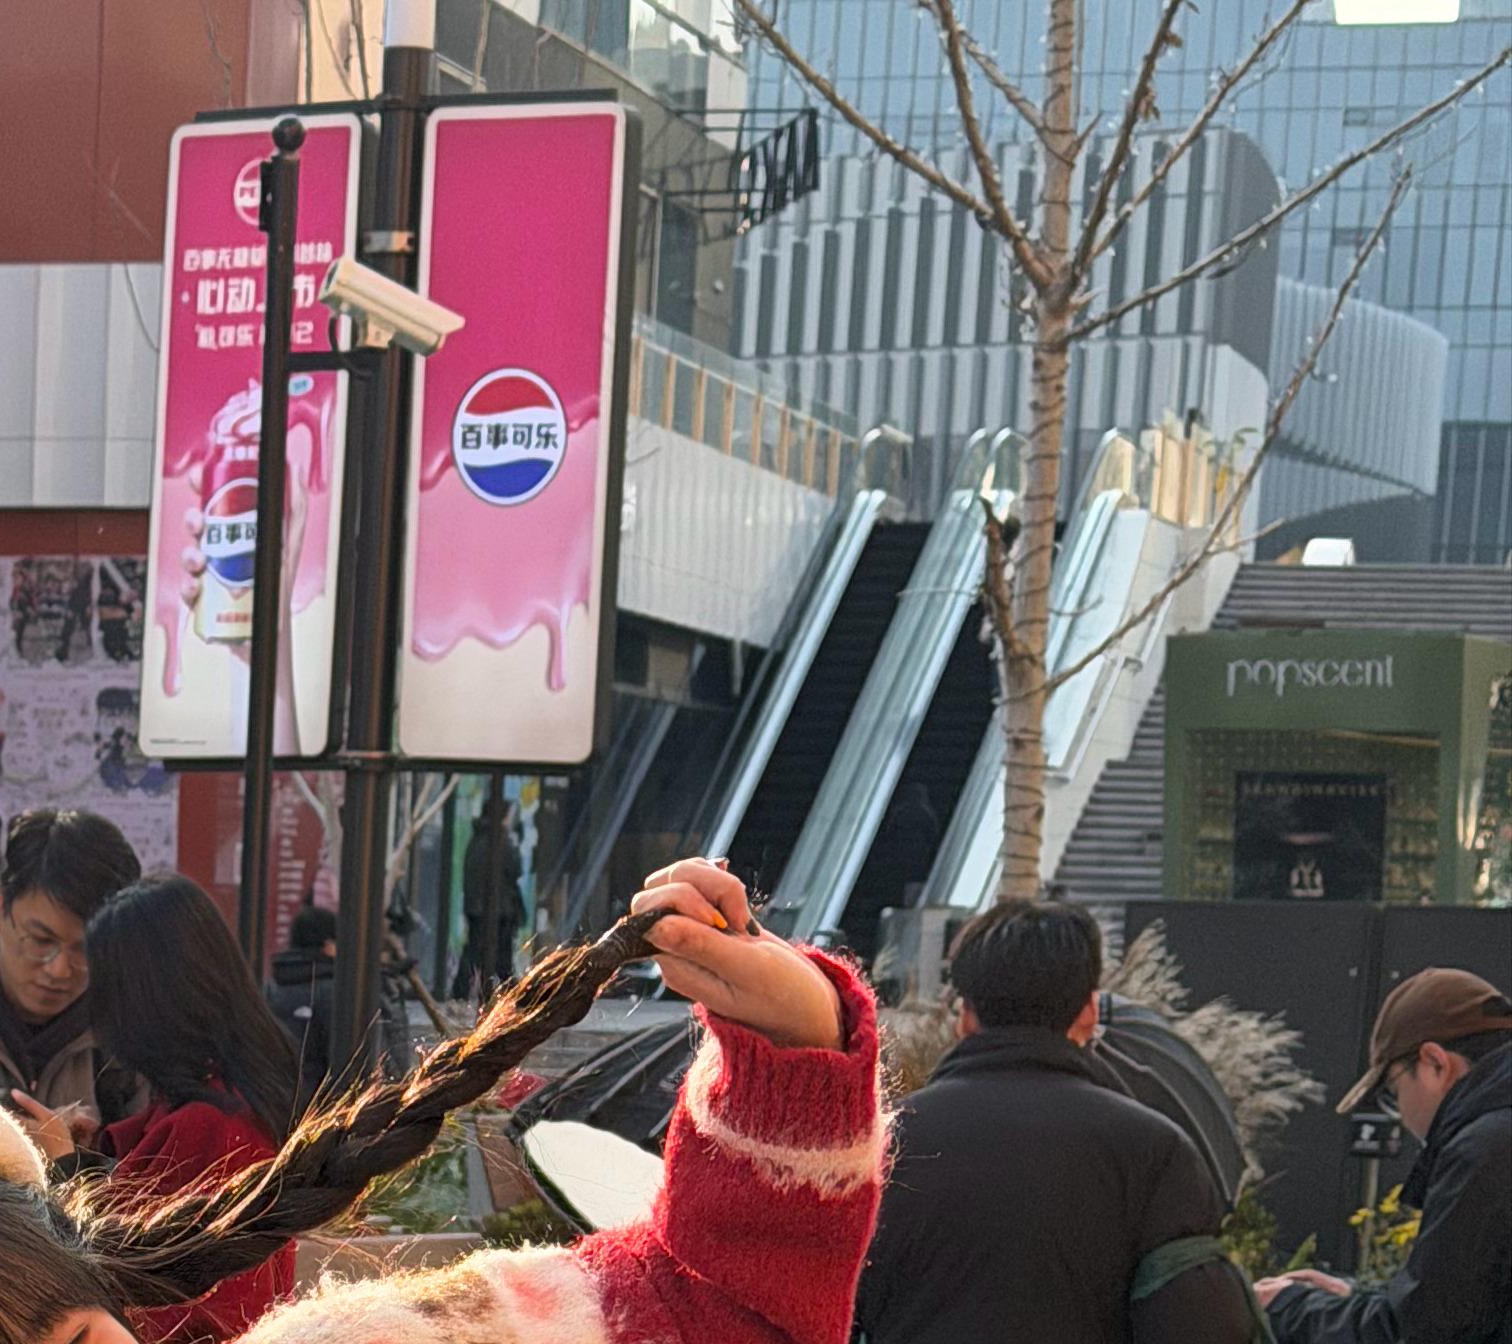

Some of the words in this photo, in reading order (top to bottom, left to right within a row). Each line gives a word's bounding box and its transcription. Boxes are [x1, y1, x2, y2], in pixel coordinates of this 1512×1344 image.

[460, 423, 558, 450] 百事可乐
[206, 523, 257, 545] 百事可
[1226, 655, 1393, 697] popscent
